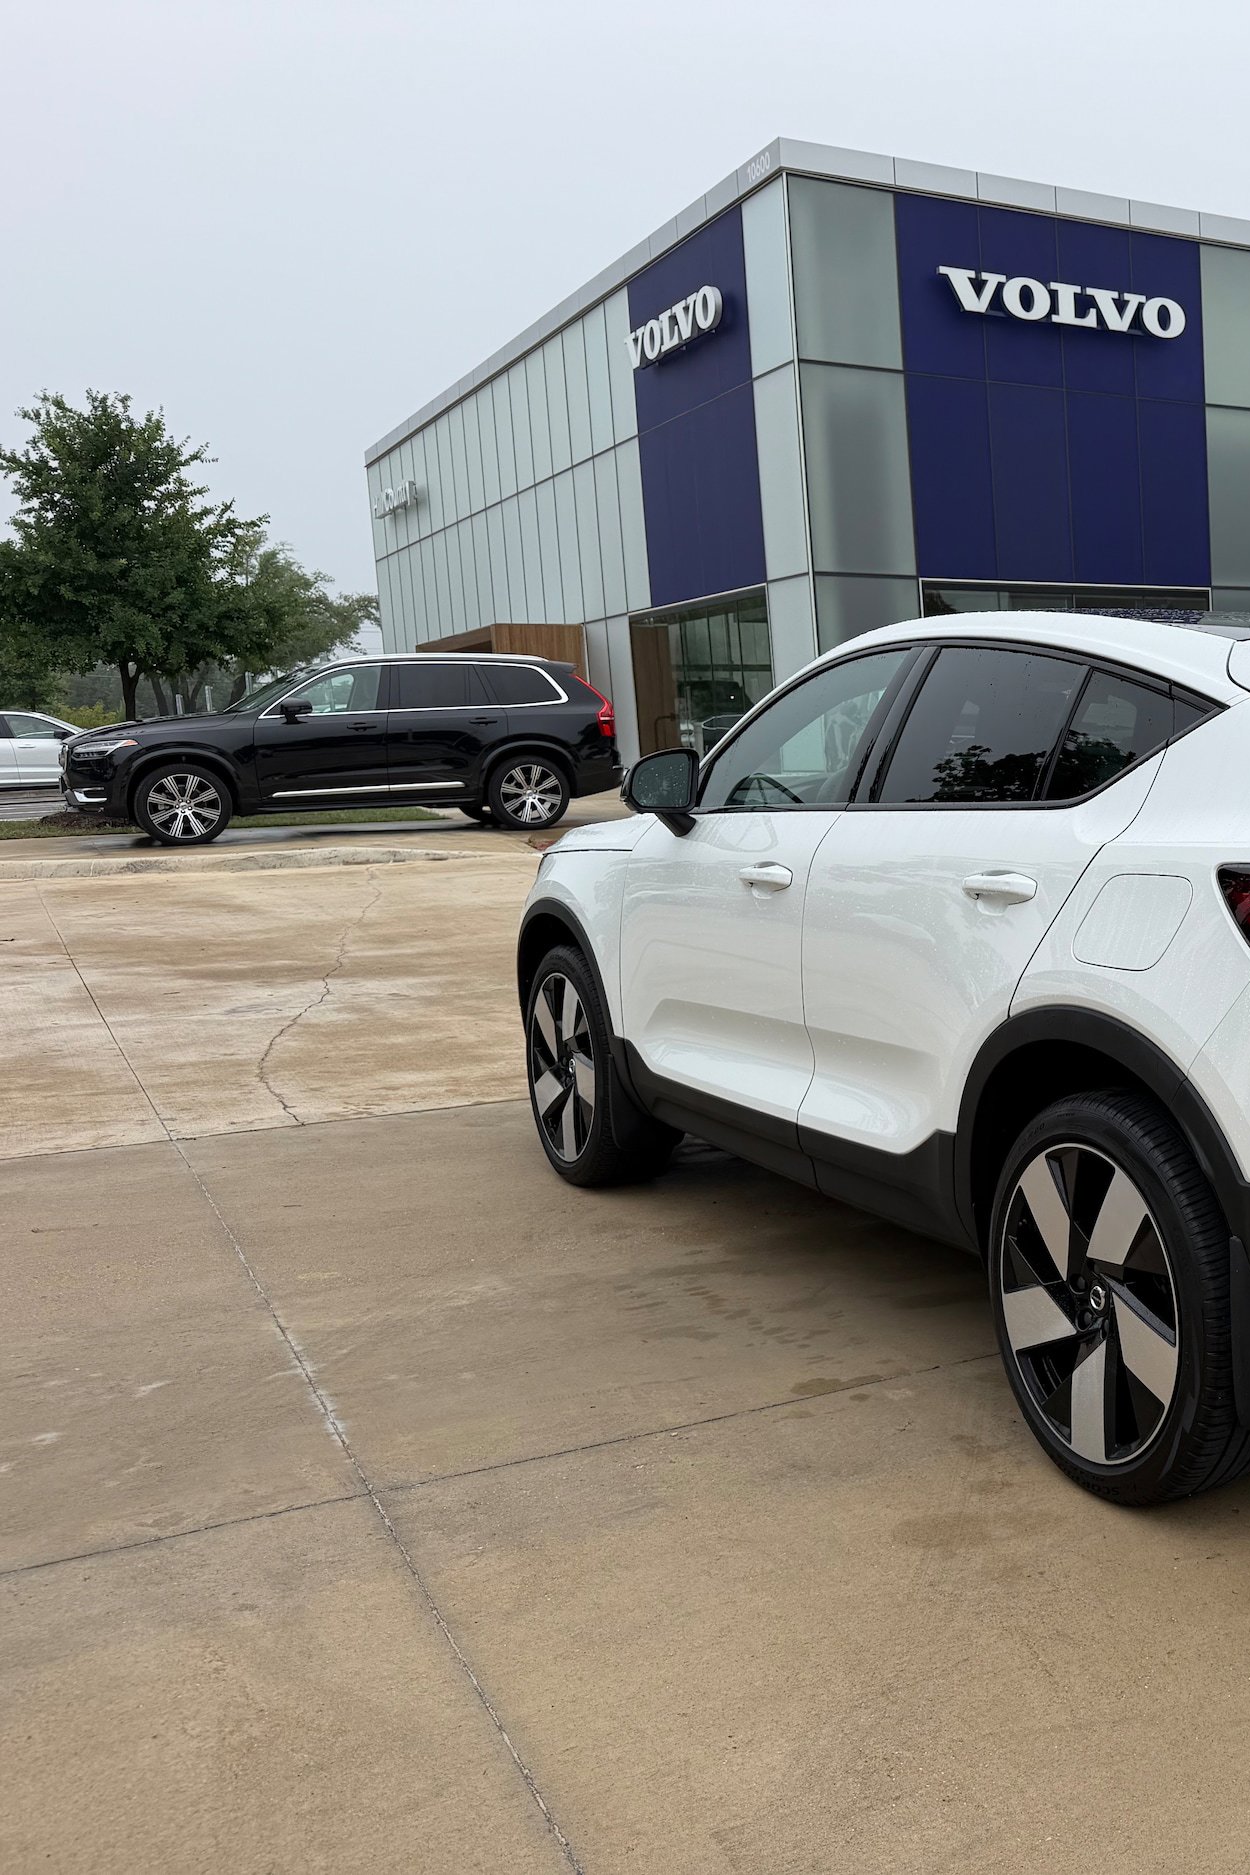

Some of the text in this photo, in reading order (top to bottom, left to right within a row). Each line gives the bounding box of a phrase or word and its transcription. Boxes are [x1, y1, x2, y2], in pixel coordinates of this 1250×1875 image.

[747, 151, 771, 182] 10600
[624, 285, 722, 369] VOLVO
[936, 265, 1186, 339] VOLVO
